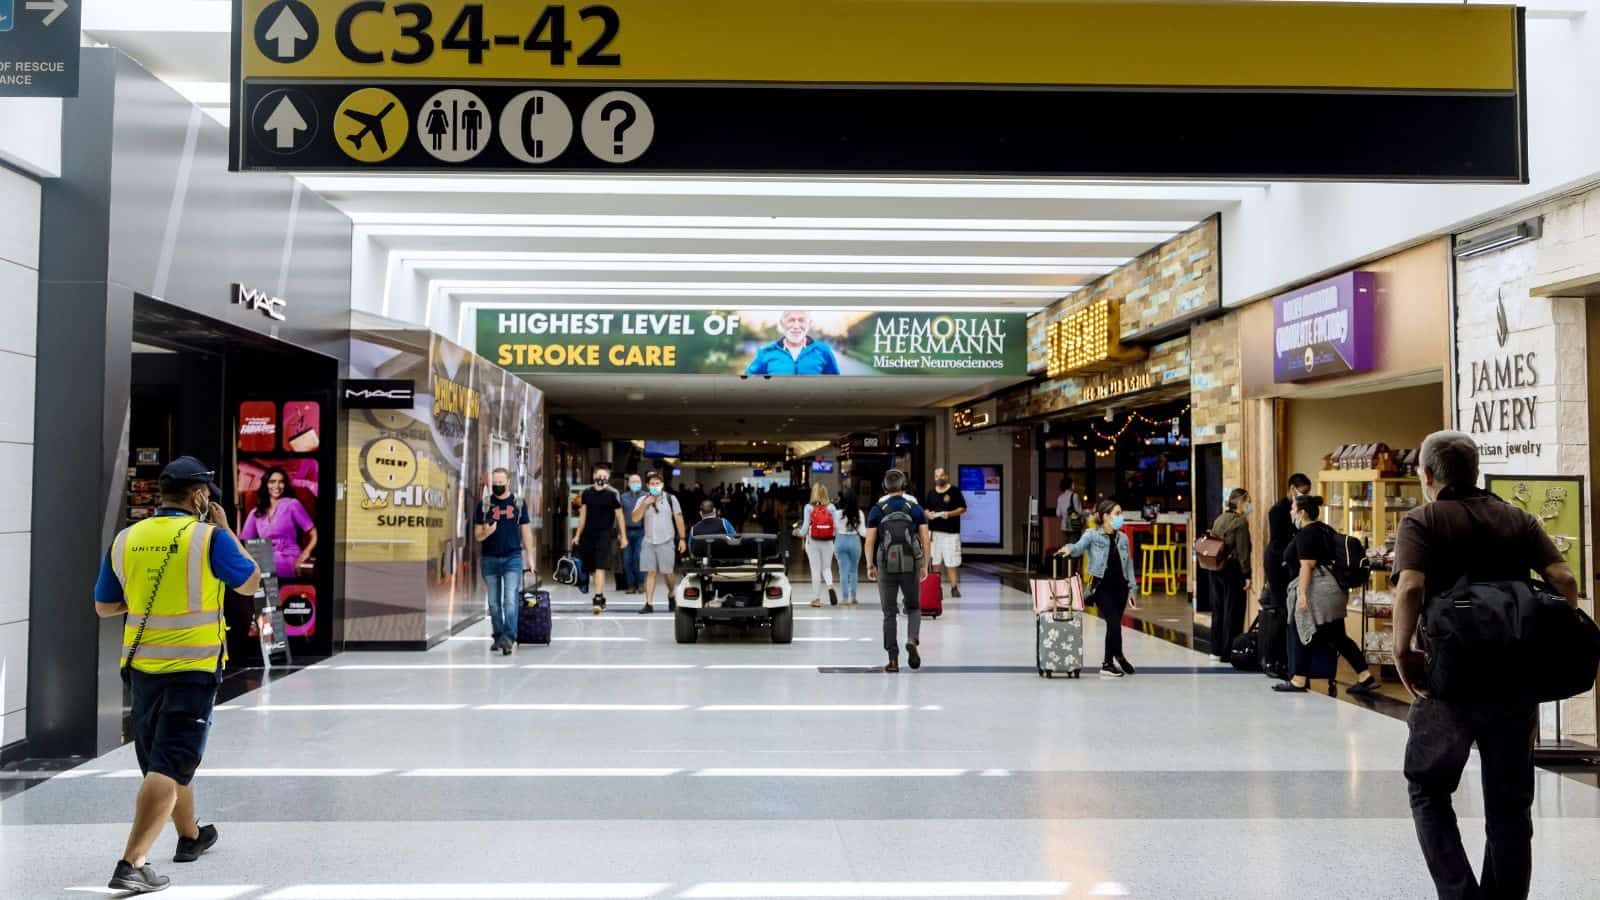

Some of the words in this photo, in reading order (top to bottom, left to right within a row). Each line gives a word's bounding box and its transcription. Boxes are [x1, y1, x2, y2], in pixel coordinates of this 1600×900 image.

[334, 1, 622, 67] C34-42
[16, 62, 65, 72] RESCUE
[236, 283, 287, 321] MAC
[498, 313, 614, 335] HIGHEST
[622, 314, 695, 335] LEVEL
[703, 315, 740, 336] OF
[874, 317, 1005, 338] MEMORIAL
[498, 344, 600, 366] STROKE
[608, 345, 676, 367] CARE
[874, 335, 1004, 354] HERMANN
[873, 355, 919, 368] Mischer
[921, 355, 1004, 369] Neurosciences
[1471, 352, 1537, 398] JAMES
[1471, 395, 1537, 434] AVERY
[1505, 440, 1542, 458] jewelry
